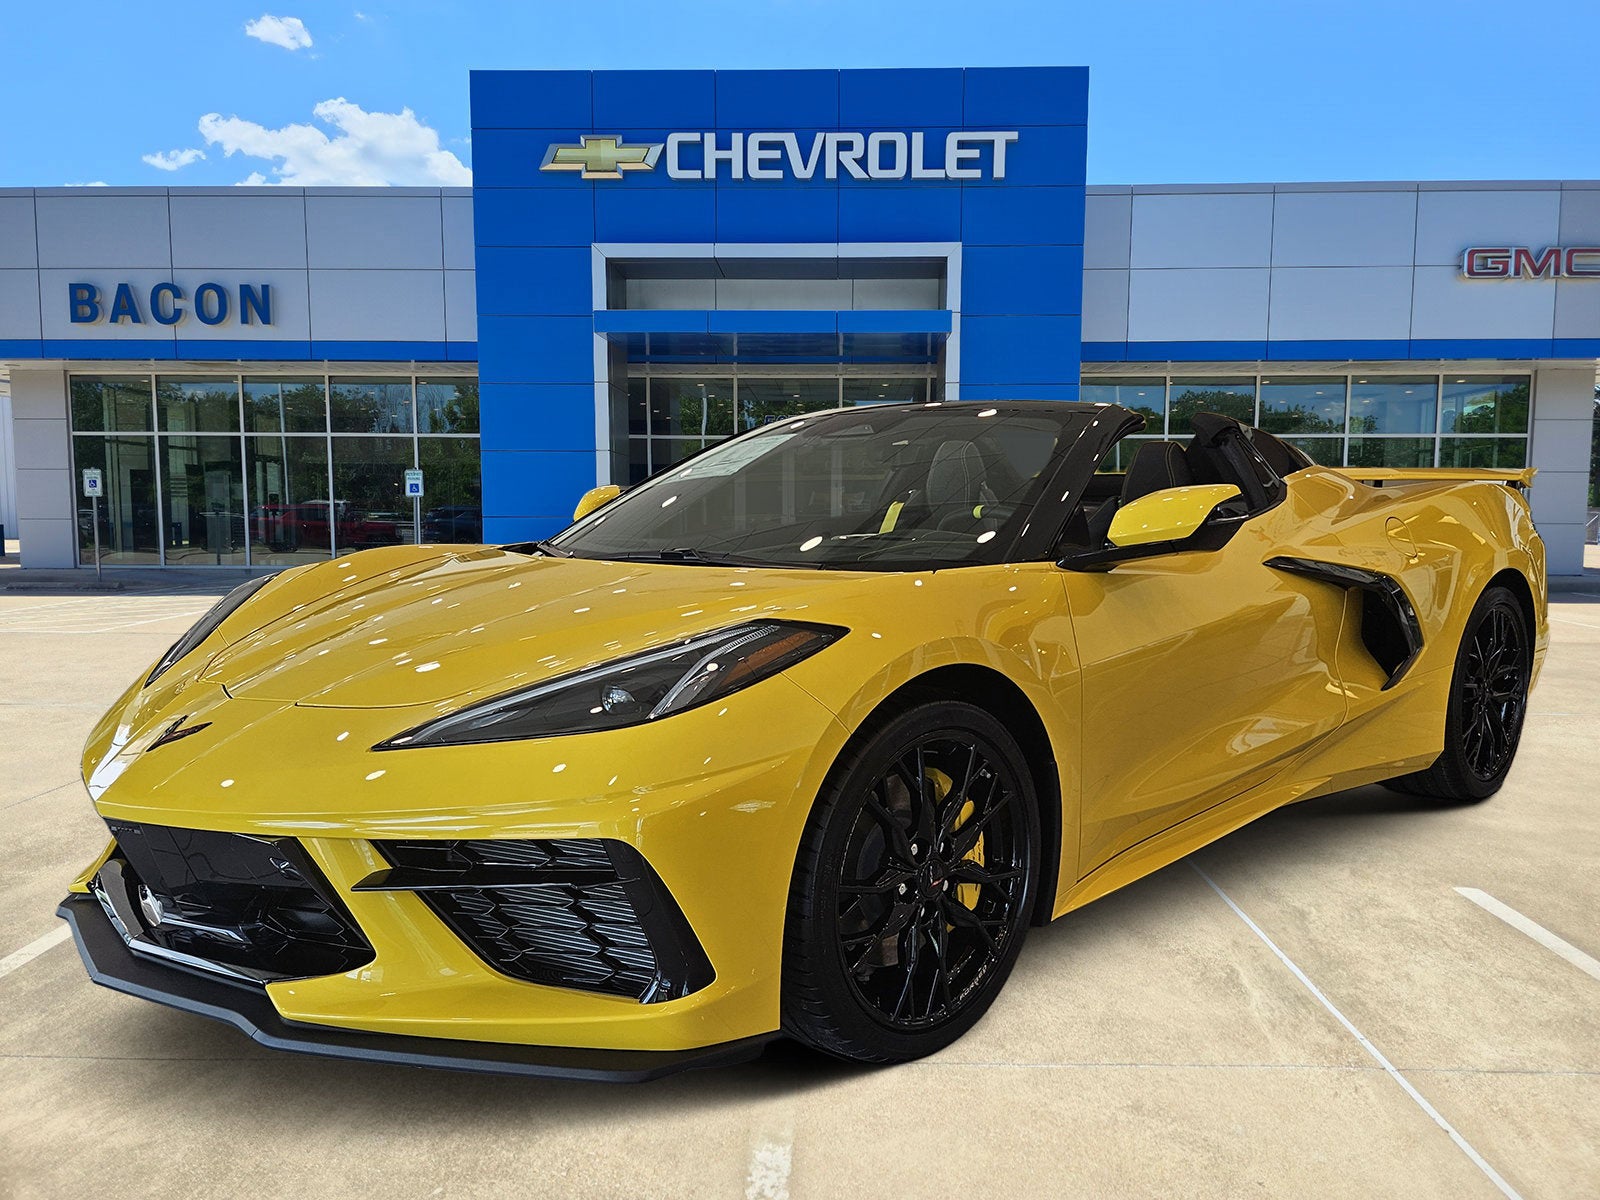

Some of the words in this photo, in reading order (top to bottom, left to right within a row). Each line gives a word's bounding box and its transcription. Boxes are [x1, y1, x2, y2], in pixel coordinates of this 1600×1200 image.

[666, 131, 1019, 181] CHEVROLET
[1463, 246, 1600, 279] GMC
[68, 281, 274, 326] BACON
